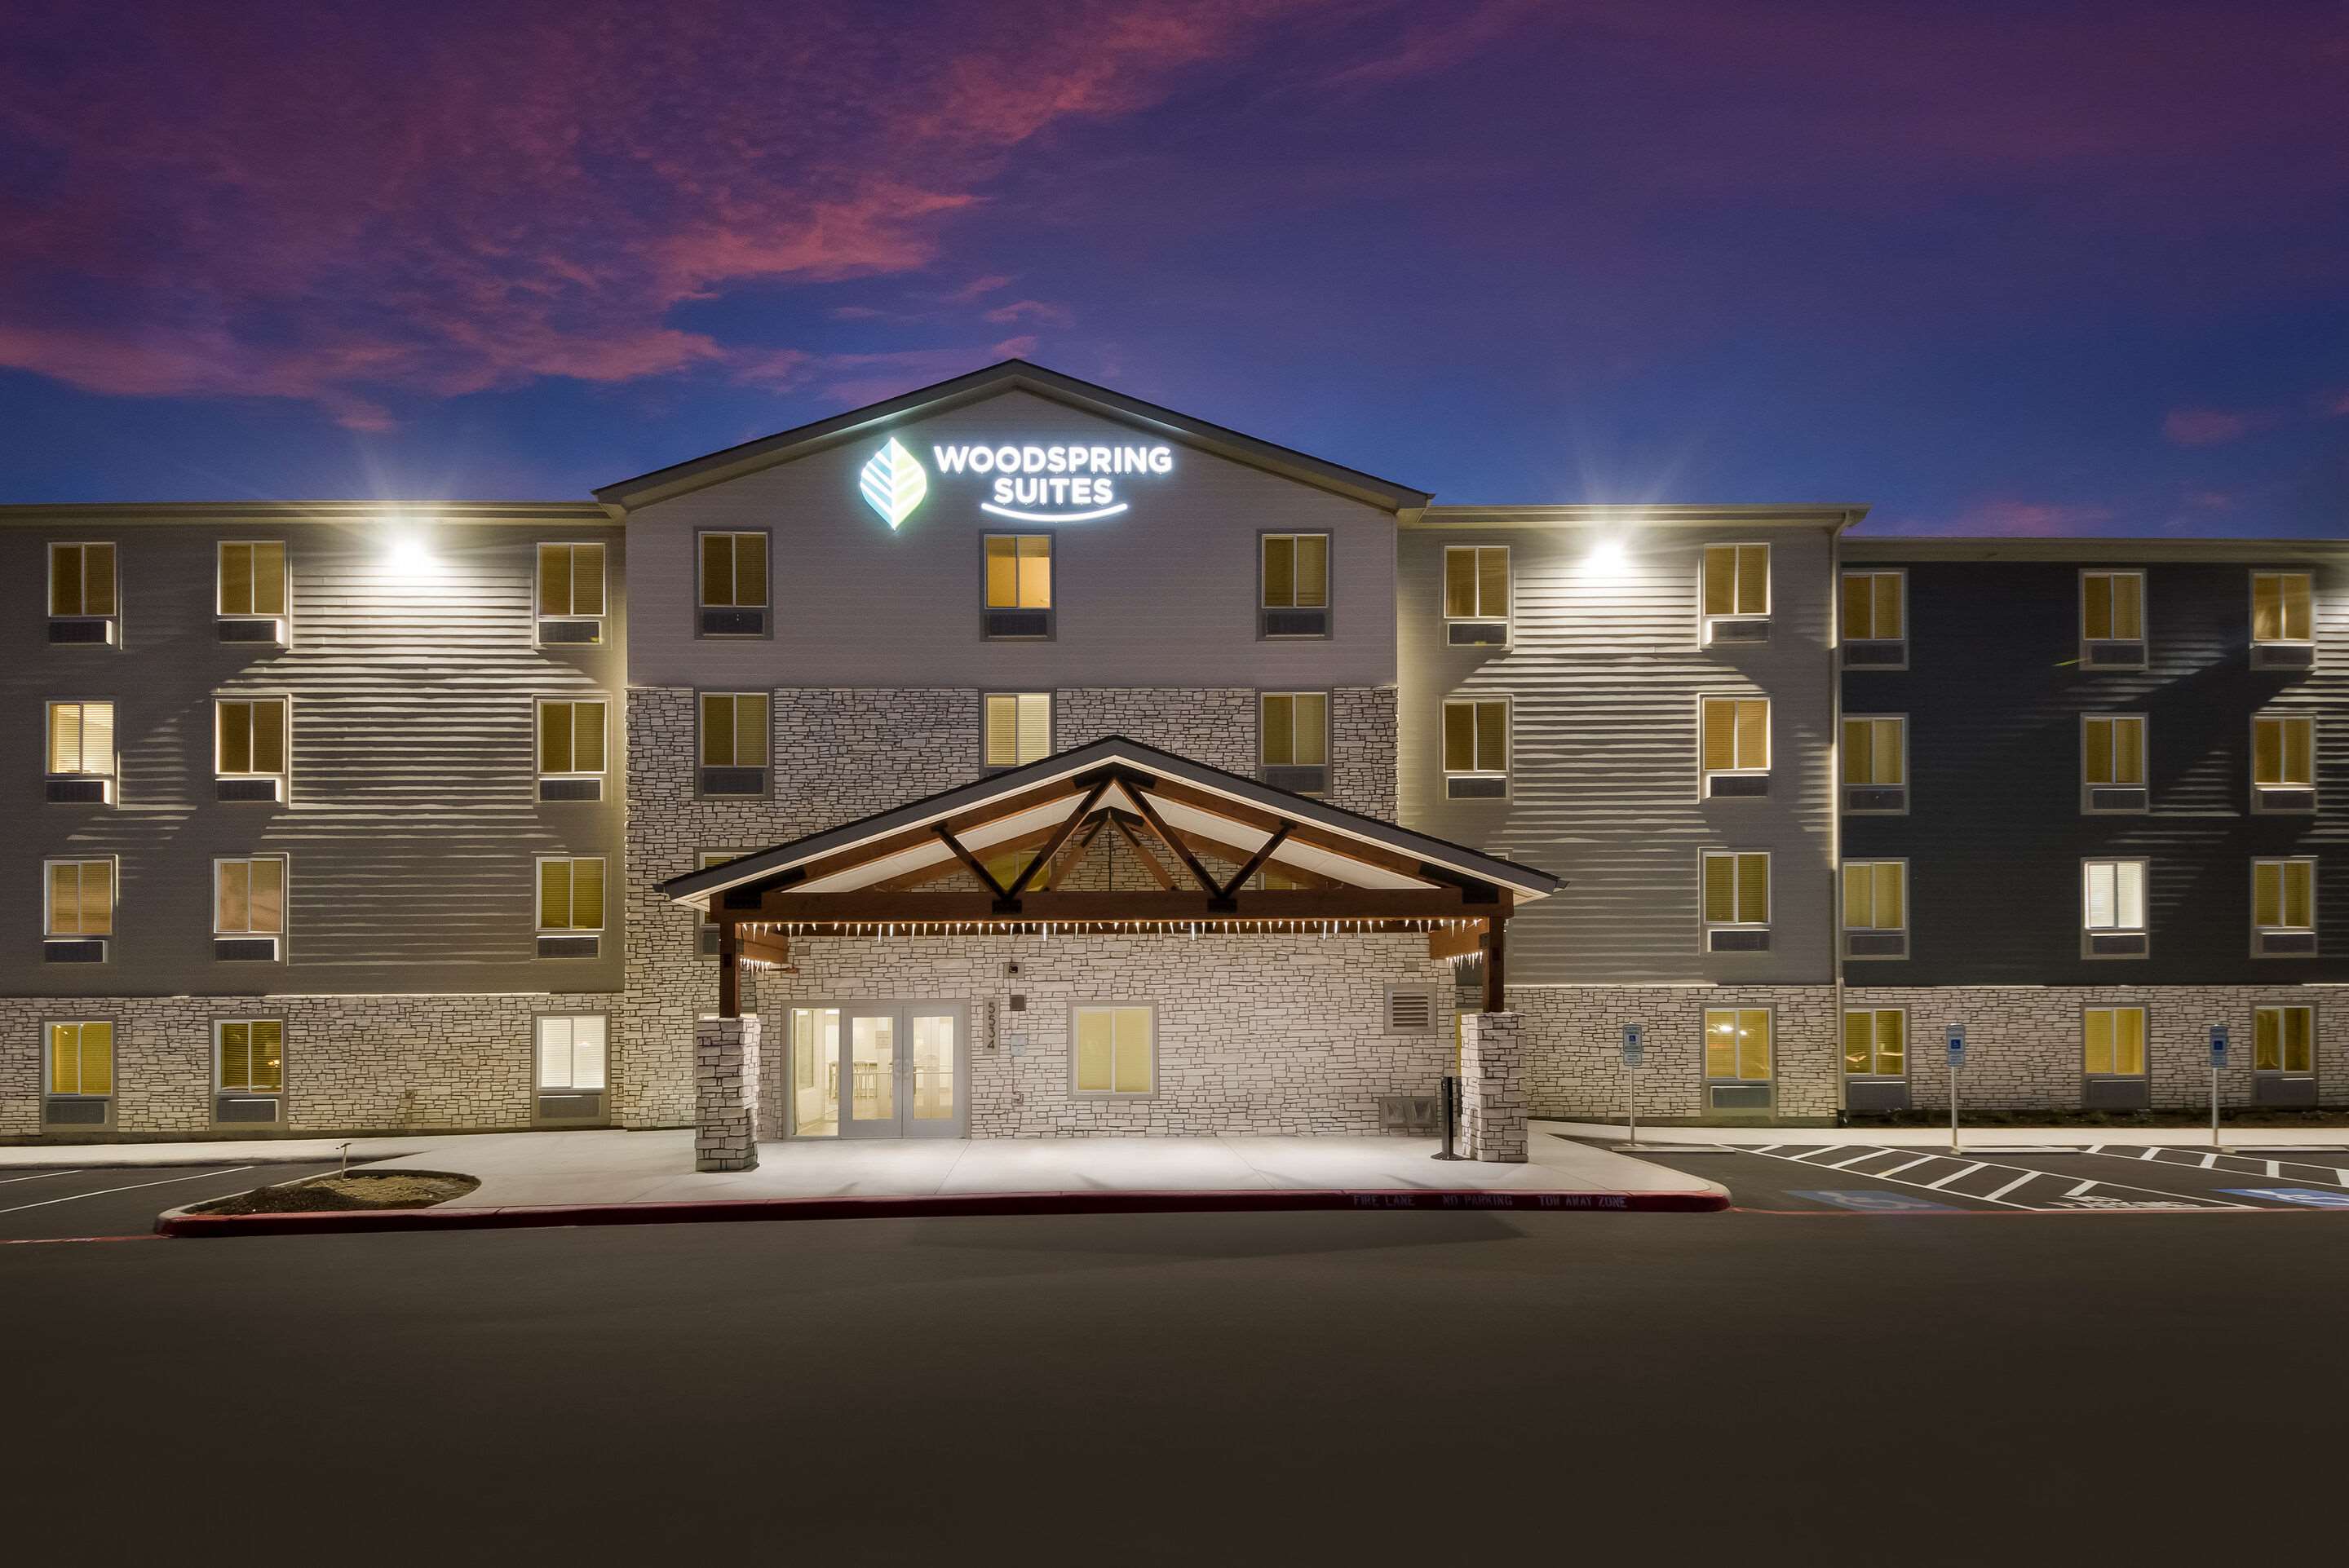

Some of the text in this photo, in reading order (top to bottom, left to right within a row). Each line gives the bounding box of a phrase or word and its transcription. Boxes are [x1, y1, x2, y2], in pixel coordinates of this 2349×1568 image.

[933, 445, 1173, 473] WOODSPRING
[993, 477, 1113, 504] SUITES
[987, 1001, 996, 1049] 5534
[1353, 1195, 1628, 1208] FIRE LANE NO PARKING TOW AWAY ZONE
